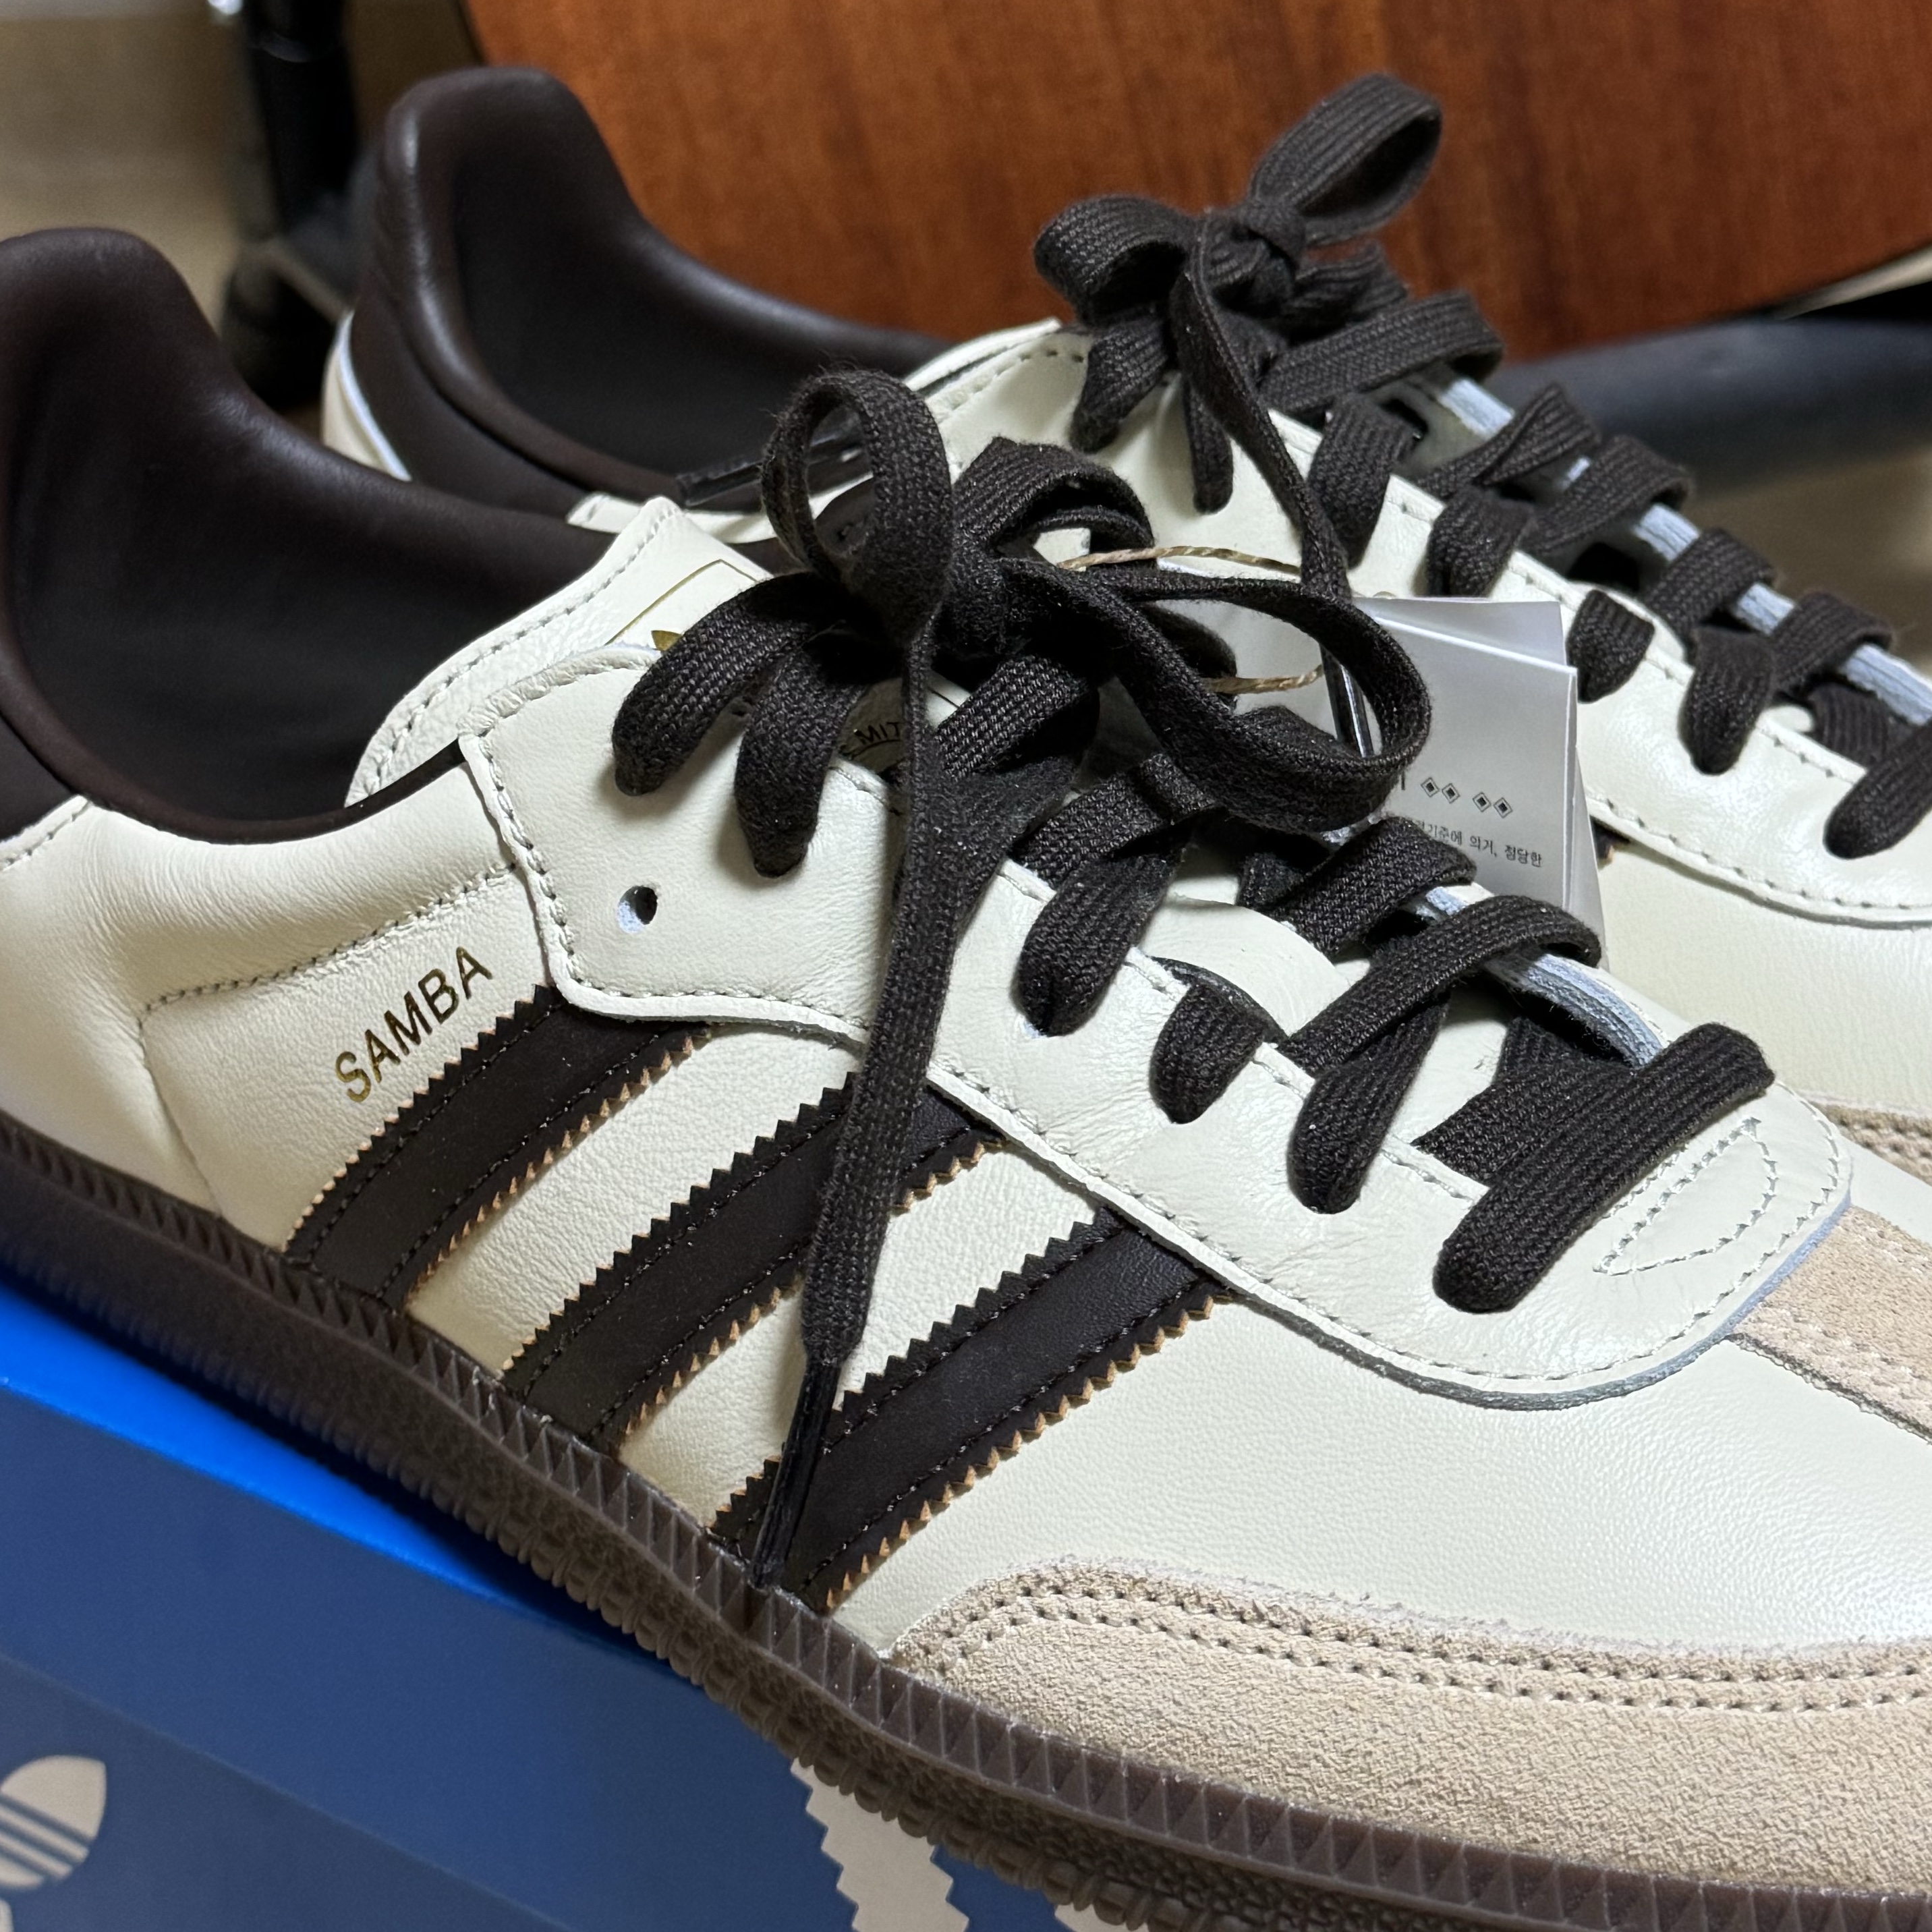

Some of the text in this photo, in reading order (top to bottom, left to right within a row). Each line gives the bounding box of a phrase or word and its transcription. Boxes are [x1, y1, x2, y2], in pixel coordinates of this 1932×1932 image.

[1470, 835, 1498, 857] 의거,
[1505, 845, 1542, 868] 정당한
[335, 946, 493, 1102] SAMBA
